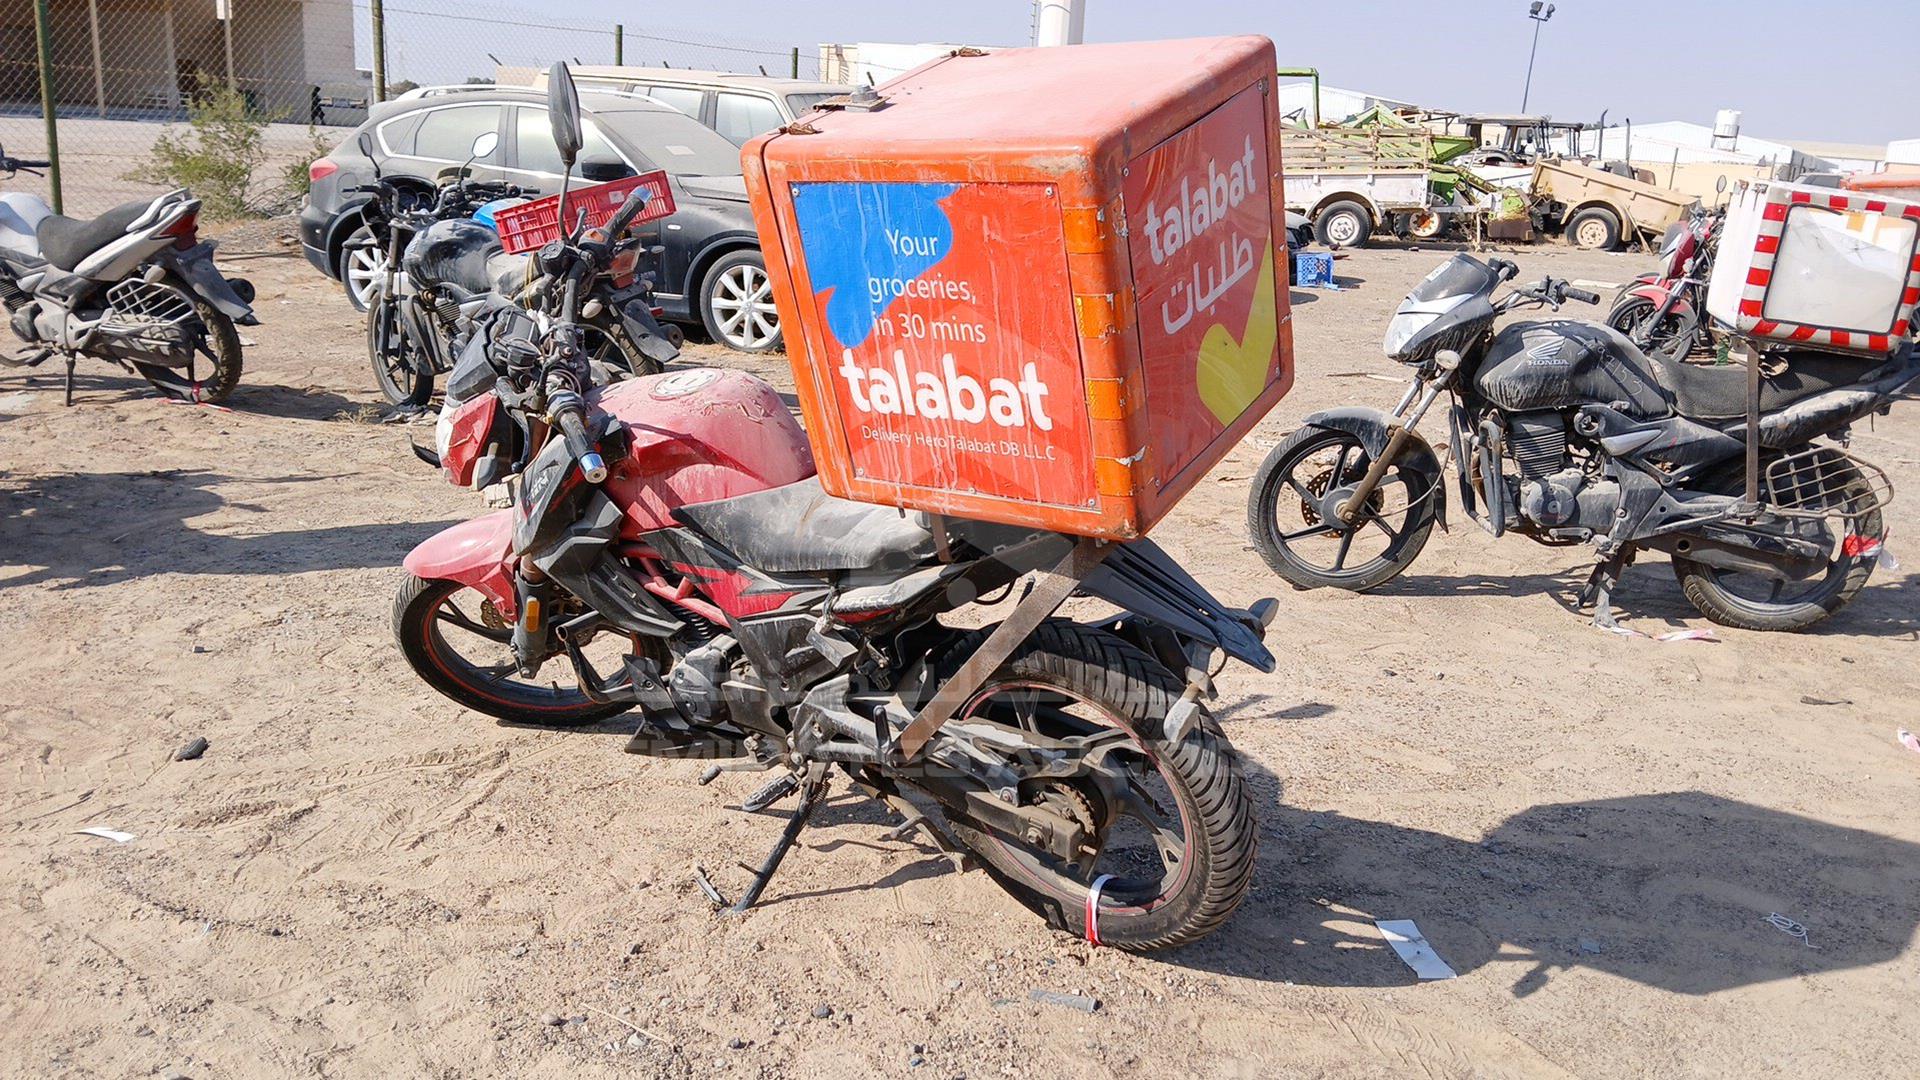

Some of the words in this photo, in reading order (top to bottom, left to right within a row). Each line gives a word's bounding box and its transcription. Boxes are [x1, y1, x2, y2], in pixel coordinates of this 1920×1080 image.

[1143, 133, 1257, 266] talabat
[884, 228, 938, 257] Your
[867, 272, 977, 304] groceries,
[1161, 232, 1254, 336] طلبات
[872, 310, 894, 338] in
[897, 313, 926, 340] 30
[931, 315, 988, 344] mins
[1527, 359, 1570, 367] HONDA
[838, 347, 1054, 432] talabat
[861, 424, 912, 448] Delivery
[915, 433, 947, 449] Hero
[947, 435, 998, 455] Talabat
[1001, 441, 1020, 457] DB
